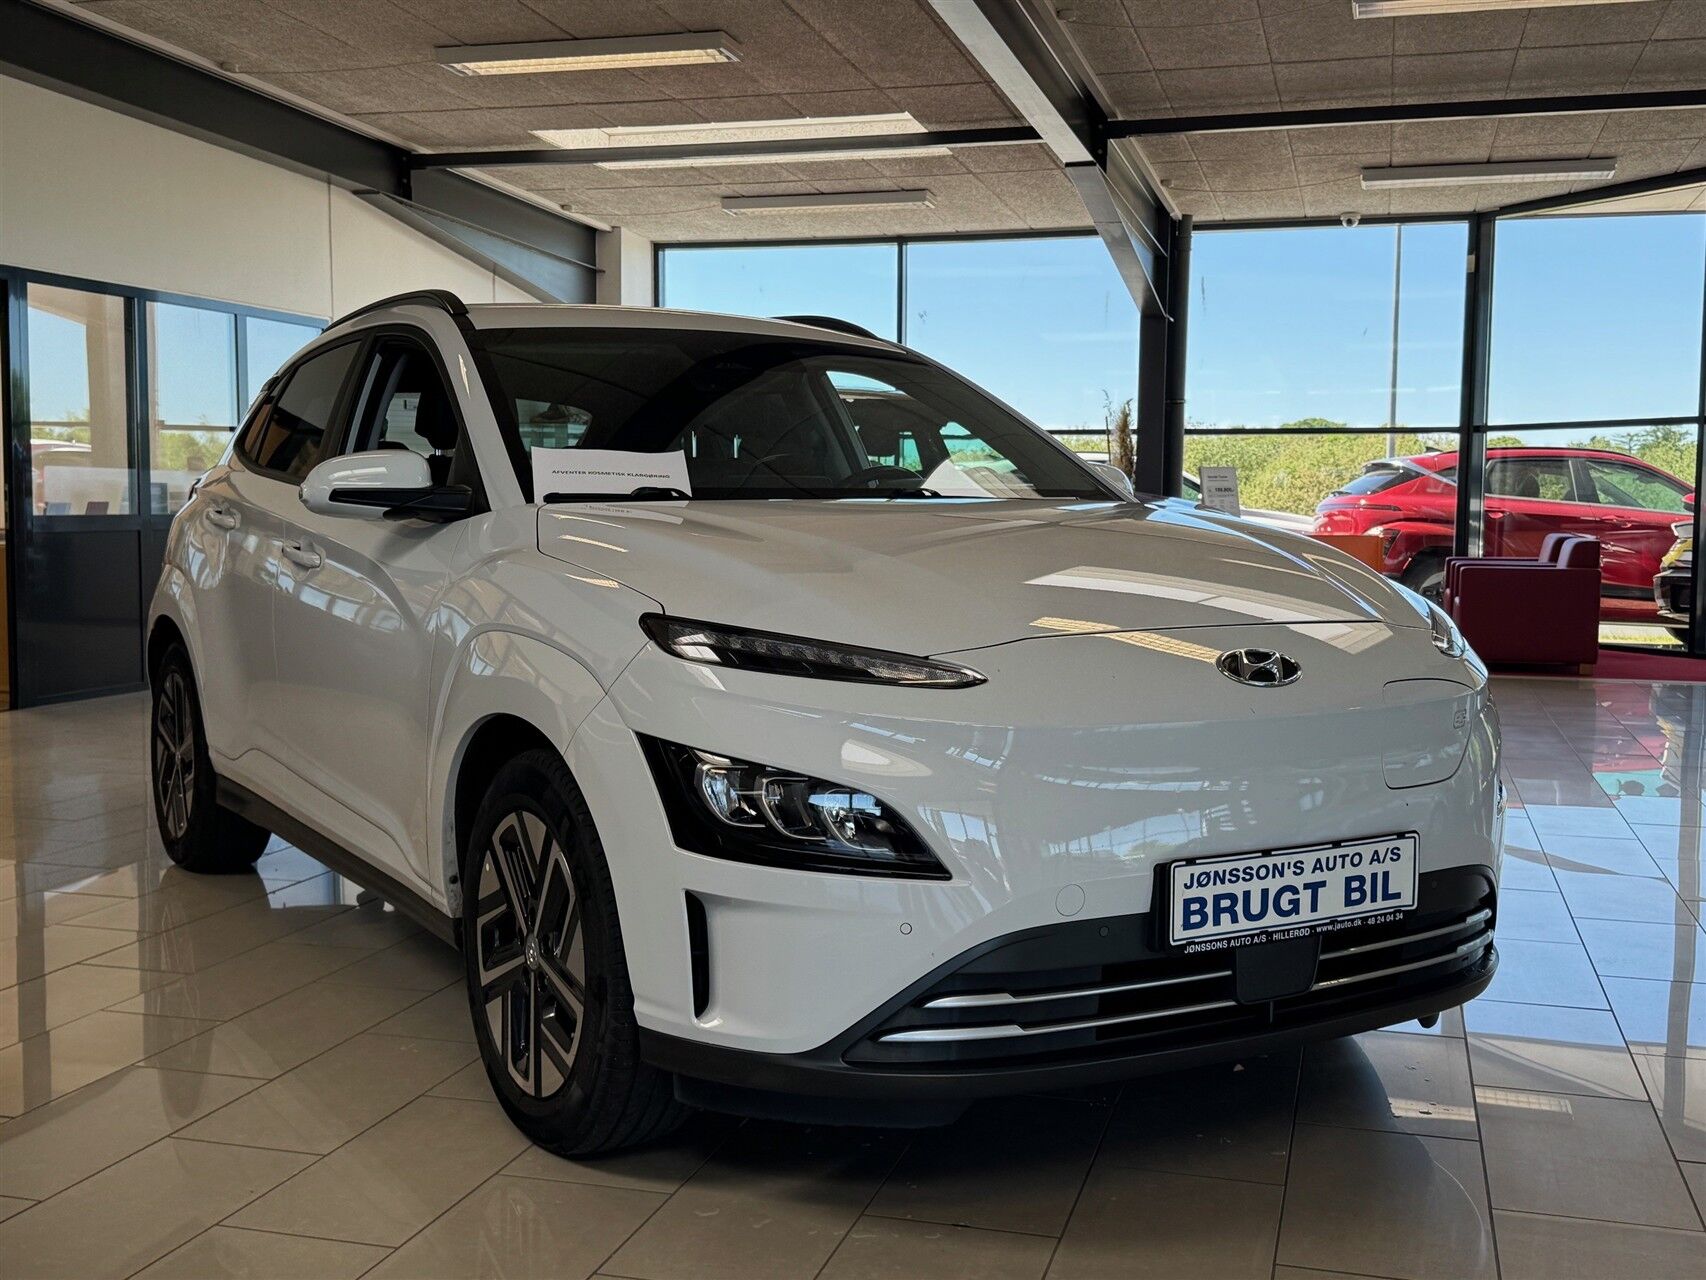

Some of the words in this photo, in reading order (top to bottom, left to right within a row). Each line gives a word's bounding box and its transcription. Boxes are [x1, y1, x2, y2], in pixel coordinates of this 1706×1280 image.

[1183, 860, 1305, 890] JØNSSON'S
[1311, 851, 1363, 874] AUTO
[1369, 846, 1401, 865] A/S
[1182, 880, 1327, 931] BRUGT
[1344, 870, 1402, 908] BIL
[1184, 941, 1228, 954] JØNSSONS
[1229, 937, 1252, 948] AUTO
[1253, 934, 1267, 944] A/S
[1272, 928, 1311, 941] HILLERØD
[1316, 919, 1362, 933] www.jauto.dk
[1376, 915, 1385, 924] 24
[1395, 912, 1404, 921] 34
